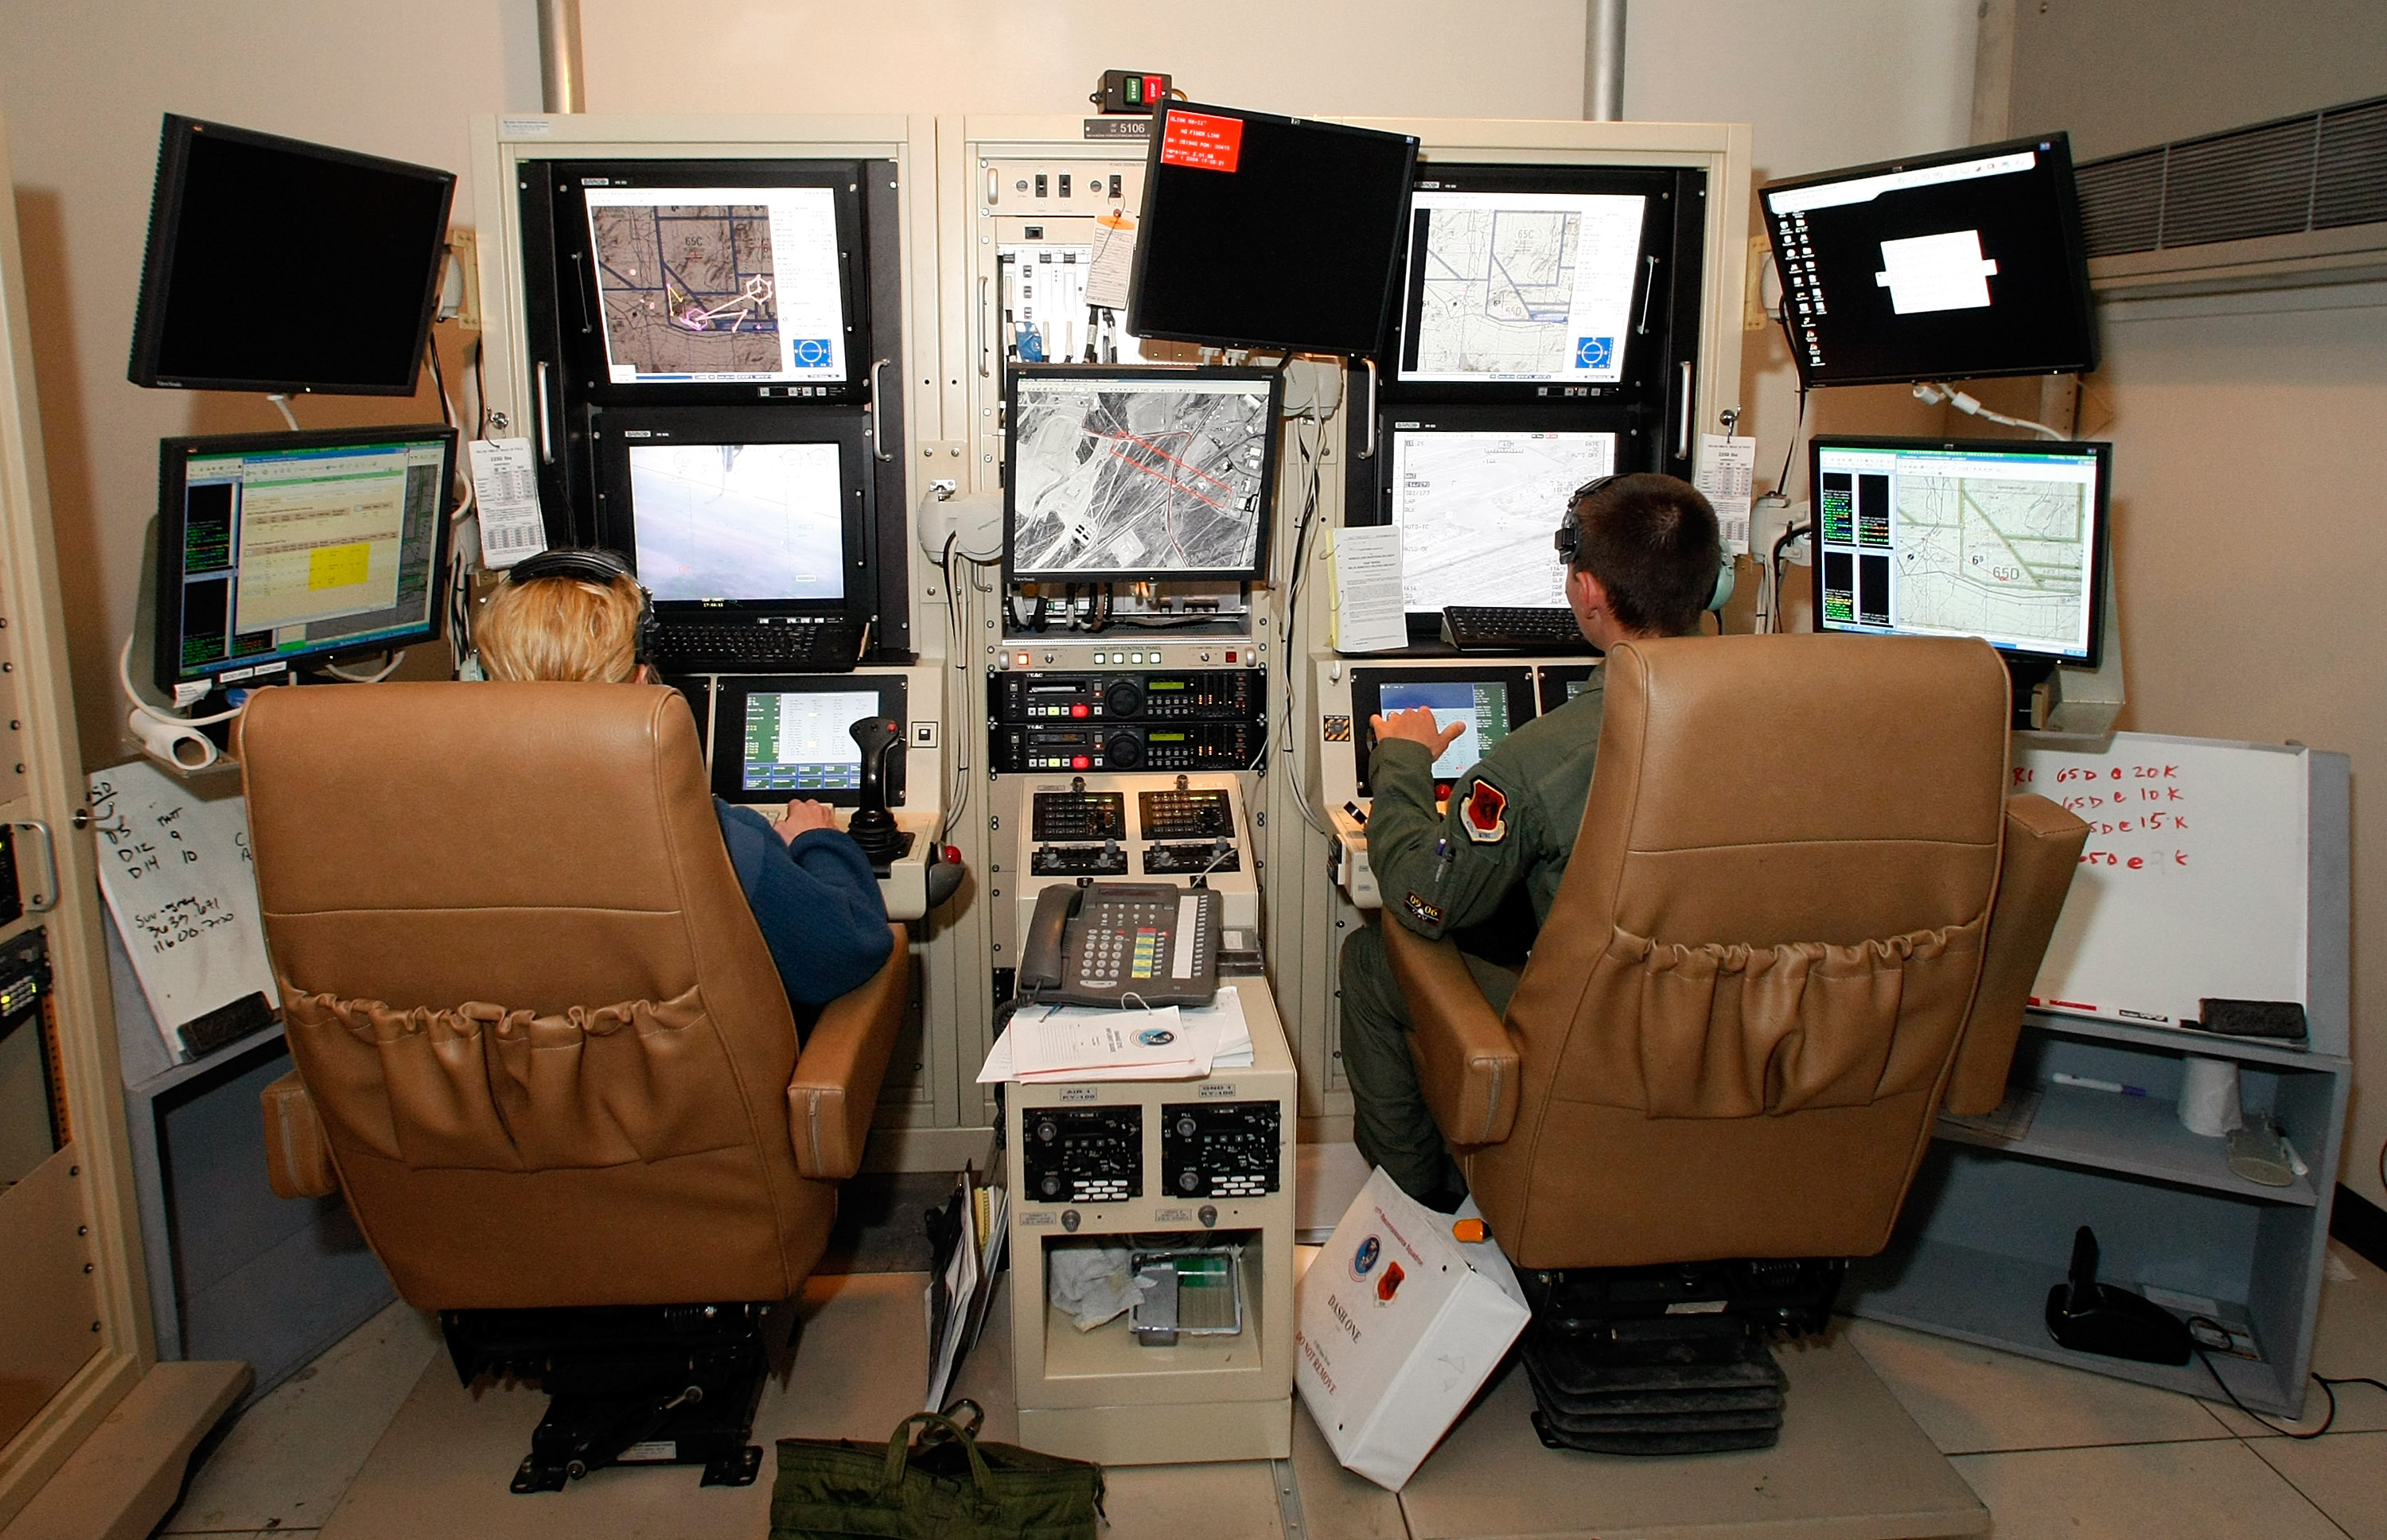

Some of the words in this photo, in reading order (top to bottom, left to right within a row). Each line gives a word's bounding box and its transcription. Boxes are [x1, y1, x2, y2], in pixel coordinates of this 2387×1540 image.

[1120, 123, 1145, 134] 5106
[1992, 566, 2020, 580] 65D
[1410, 895, 1422, 908] 09
[1424, 905, 1439, 917] 06
[1328, 1294, 1346, 1324] DASH
[1345, 1319, 1362, 1345] ONE
[1295, 1331, 1306, 1346] DO
[1304, 1340, 1316, 1362] NOT
[1312, 1355, 1338, 1396] REMOVE
